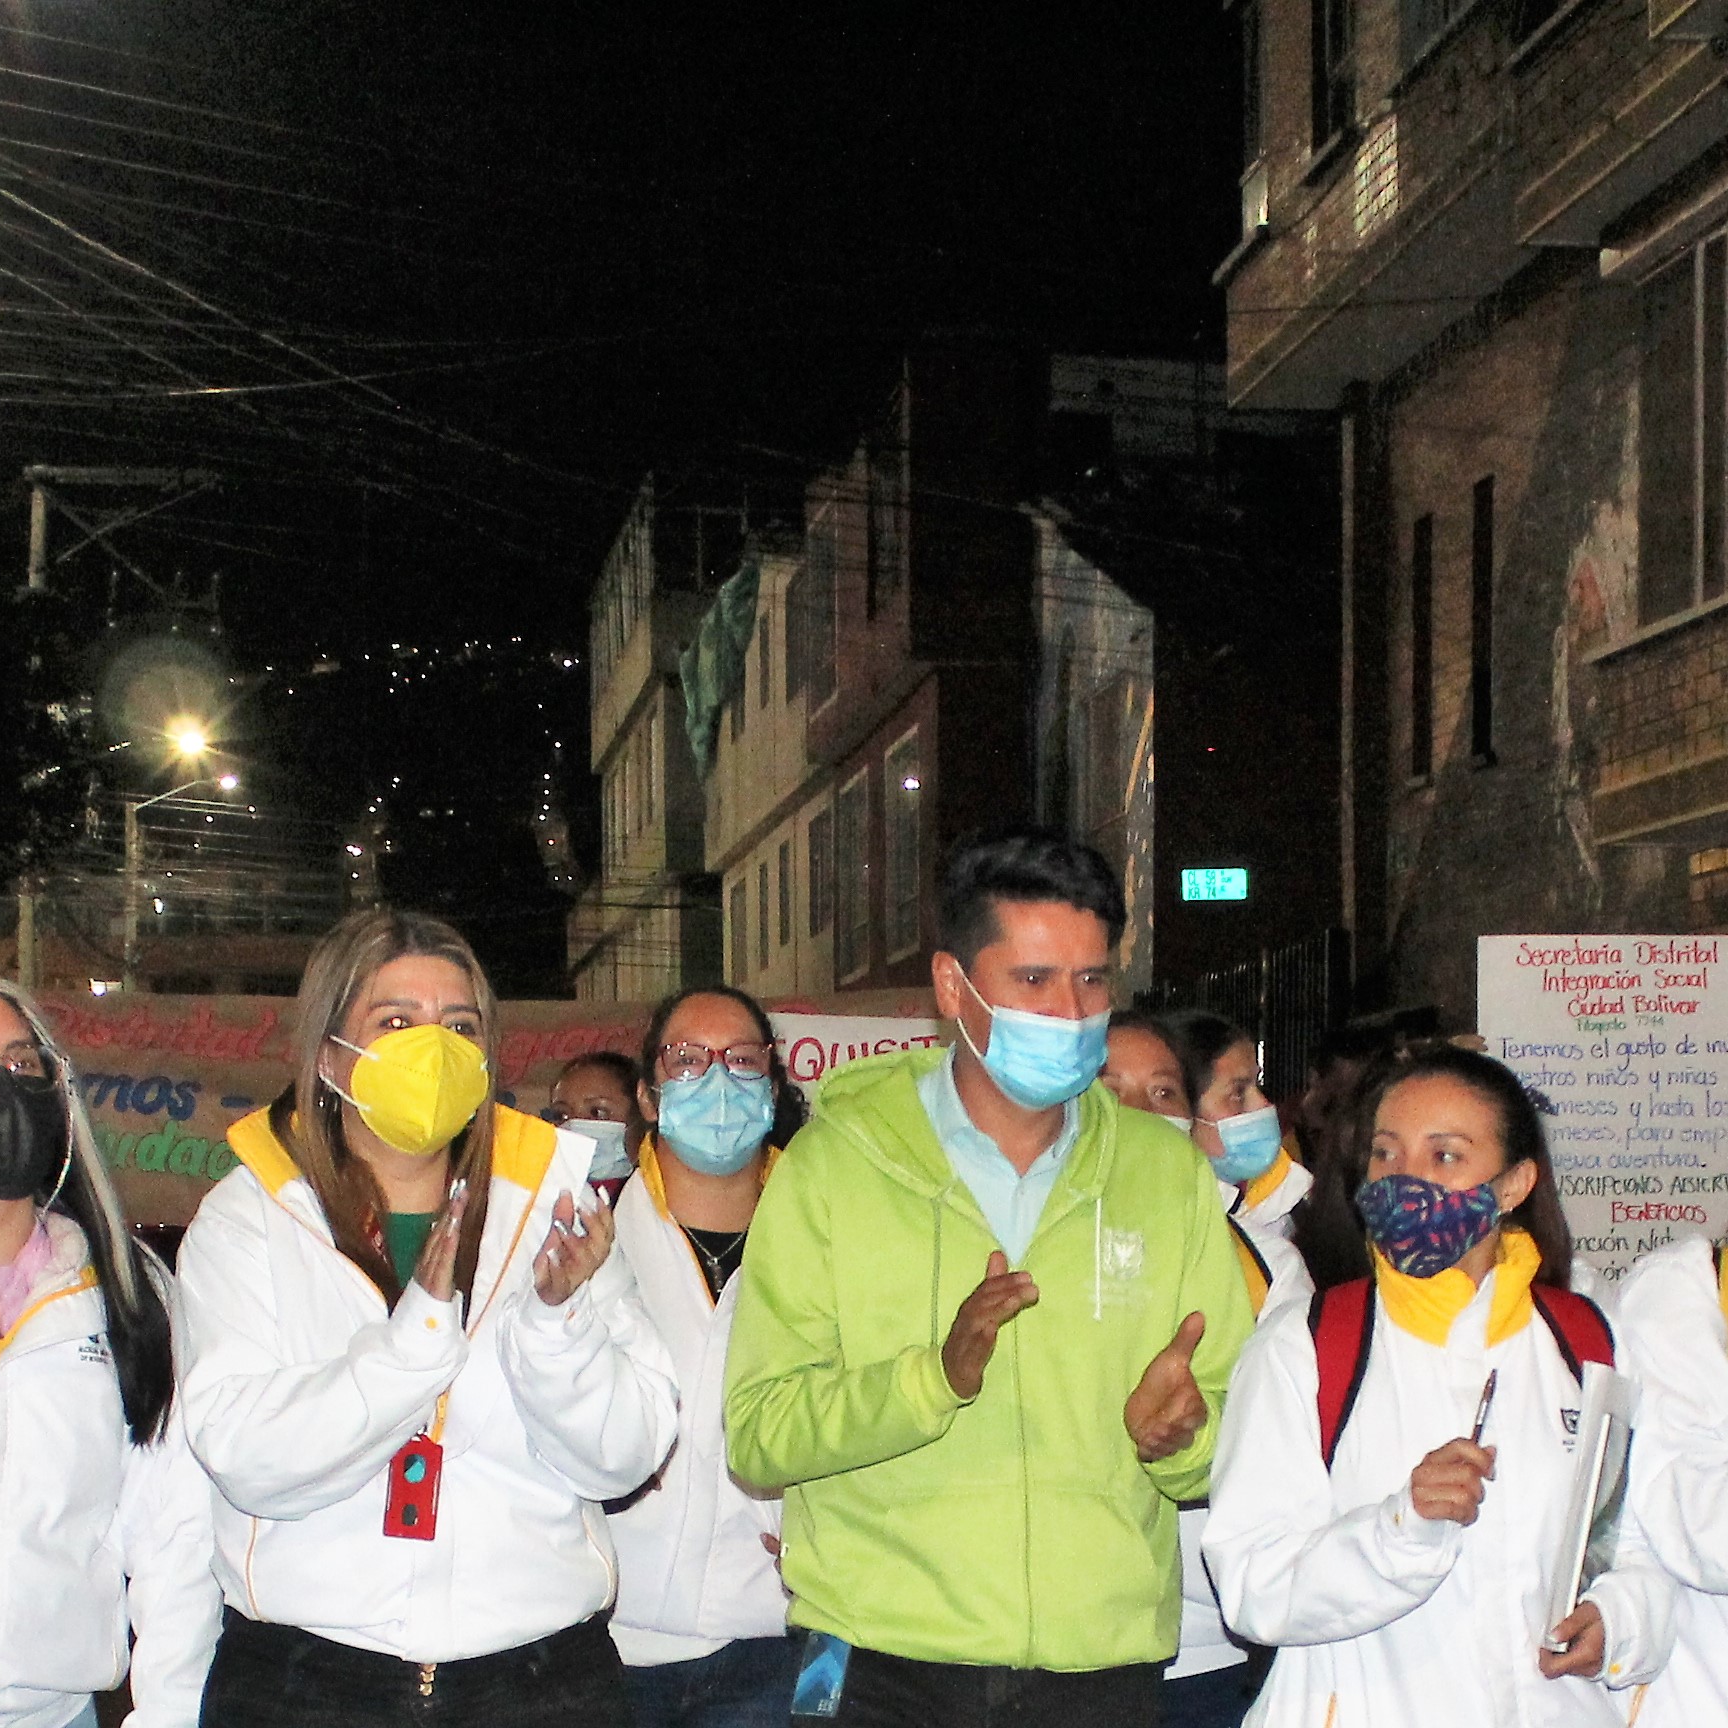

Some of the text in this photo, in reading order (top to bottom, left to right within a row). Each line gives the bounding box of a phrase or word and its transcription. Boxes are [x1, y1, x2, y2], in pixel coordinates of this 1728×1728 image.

[1633, 939, 1718, 966] Distrital
[1543, 967, 1708, 1000] Integración Social
[1500, 1036, 1584, 1061] Tenemos
[1590, 1037, 1610, 1060] el
[1616, 1033, 1667, 1071] gusto
[1675, 1033, 1699, 1056] de
[1648, 1071, 1661, 1093] y
[1667, 1066, 1719, 1086] niñas
[1629, 1101, 1643, 1127] y
[1648, 1094, 1696, 1119] hasta
[1552, 1152, 1601, 1169] ueva
[1610, 1201, 1708, 1225] BENEFICIOS
